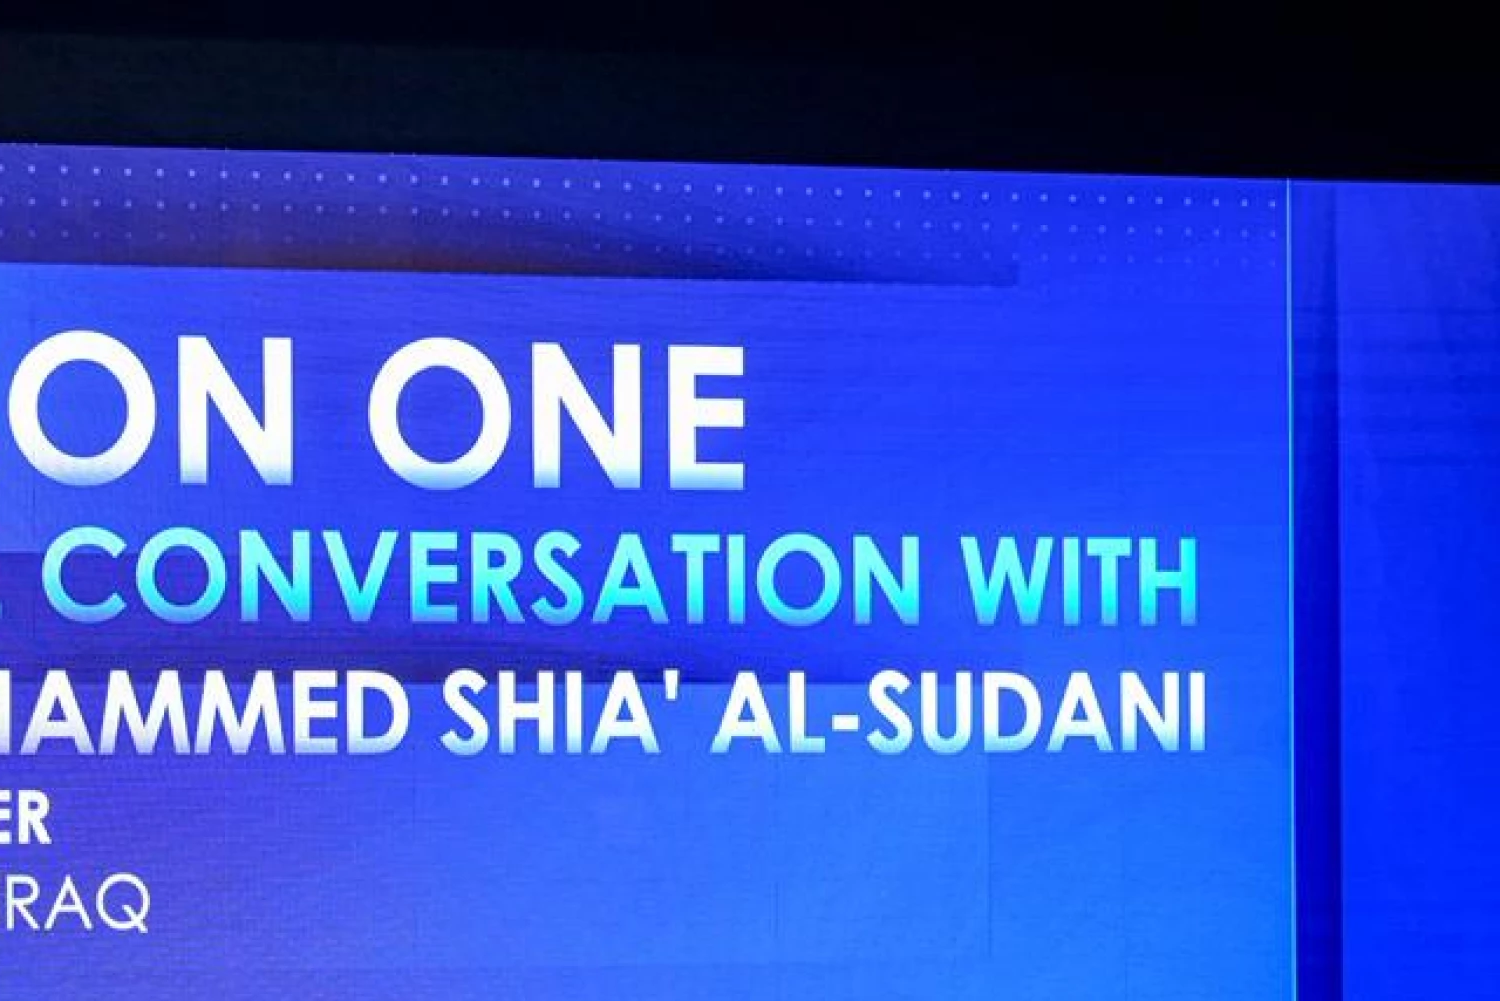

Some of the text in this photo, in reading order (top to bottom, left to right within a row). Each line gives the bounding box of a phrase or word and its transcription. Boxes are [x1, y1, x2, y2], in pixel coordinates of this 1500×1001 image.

[367, 336, 746, 491] ONE
[41, 525, 921, 628] CONVERSATION
[959, 535, 1199, 628] WITH
[440, 667, 680, 756] SHIA'
[710, 669, 1207, 756] AL-SUDANI
